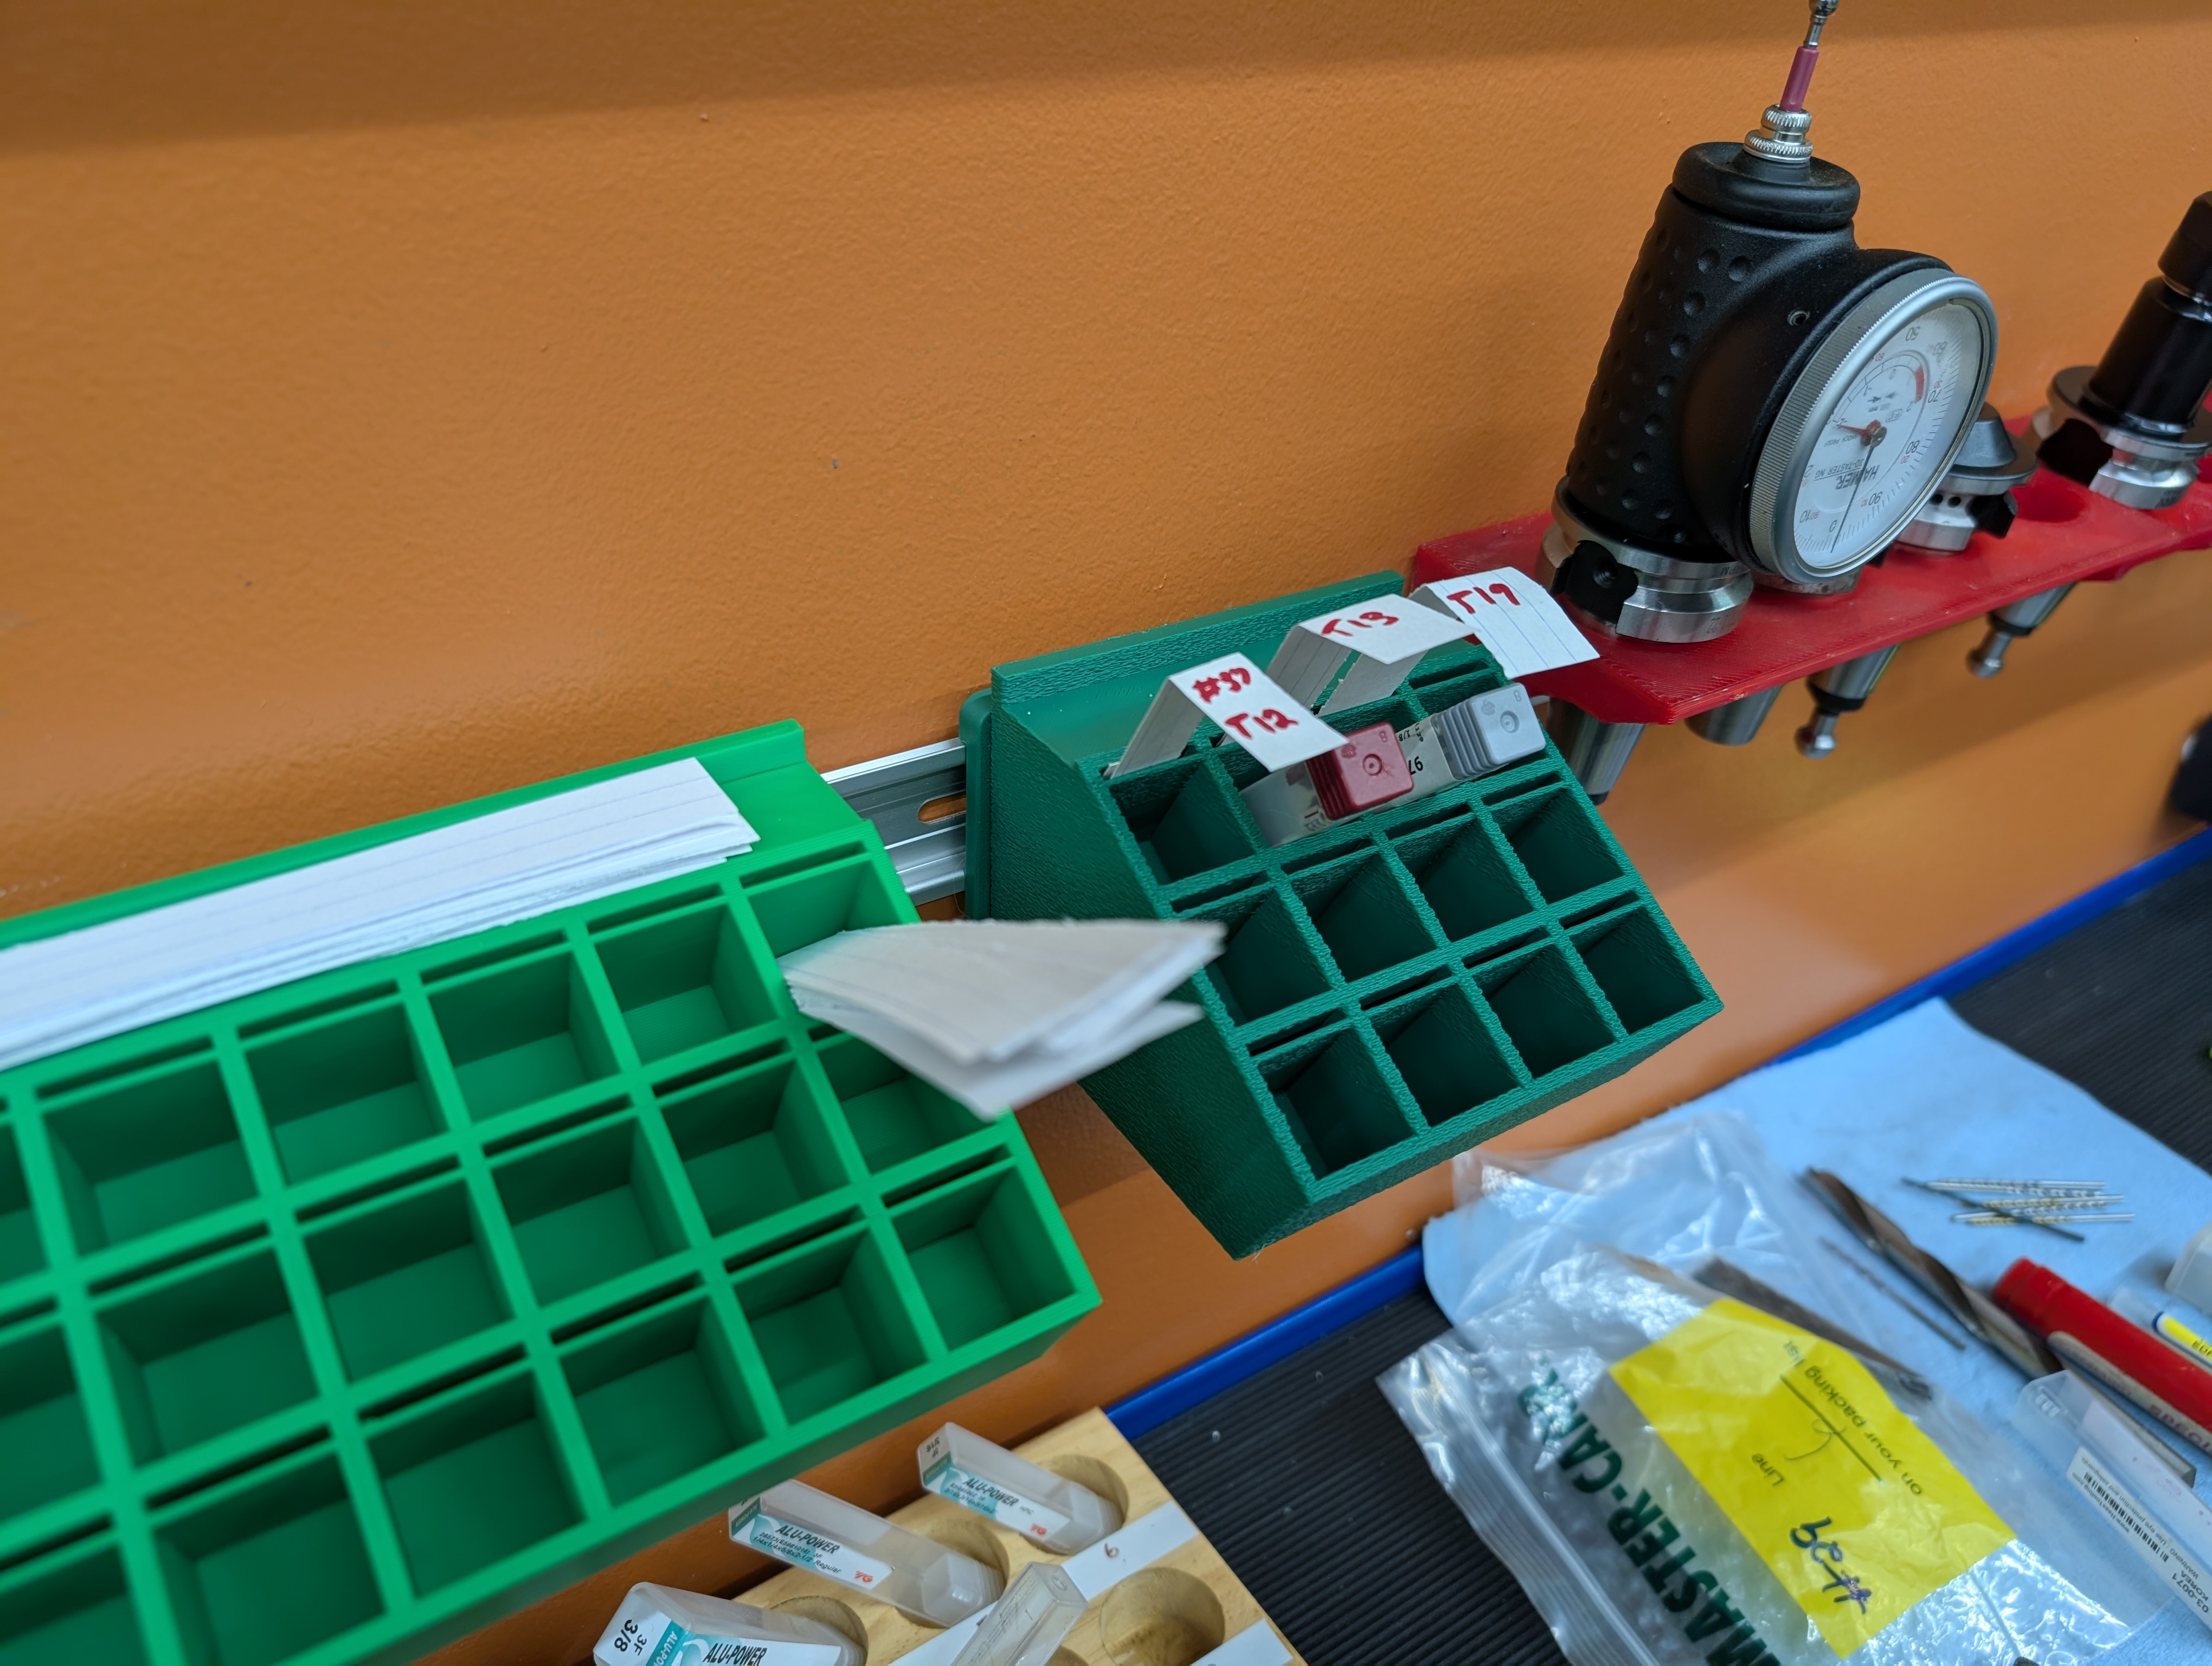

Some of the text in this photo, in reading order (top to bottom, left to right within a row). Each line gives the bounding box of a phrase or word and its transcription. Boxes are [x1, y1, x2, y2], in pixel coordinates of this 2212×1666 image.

[1906, 326, 1920, 341] 50
[1928, 389, 1941, 403] 70
[1906, 440, 1920, 454] 80
[1826, 458, 1864, 476] 3D-TASTER
[1901, 456, 1910, 464] 20
[1836, 464, 1881, 490] HAMER
[1861, 499, 1868, 507] 10
[1868, 491, 1882, 506] 90
[1799, 510, 1811, 523] 10
[1829, 520, 1837, 533] 0
[1446, 583, 1521, 614] T19
[1225, 712, 1299, 739] T12
[1783, 1341, 1922, 1495] on your packing list
[1751, 1453, 1785, 1486] Line
[963, 1477, 1020, 1507] ALU-POWER
[2119, 1496, 2146, 1523] protection
[2145, 1521, 2156, 1533] eye
[775, 1524, 840, 1554] ALU-POWER
[2155, 1533, 2166, 1546] Use
[814, 1560, 841, 1573] Regular
[2169, 1548, 2198, 1579] WARNING
[2171, 1573, 2209, 1614] 03-0071
[2181, 1570, 2209, 1601] KOREA
[614, 1619, 639, 1652] 3/8
[634, 1634, 647, 1656] 3F
[702, 1643, 768, 1666] ALU-POWER
